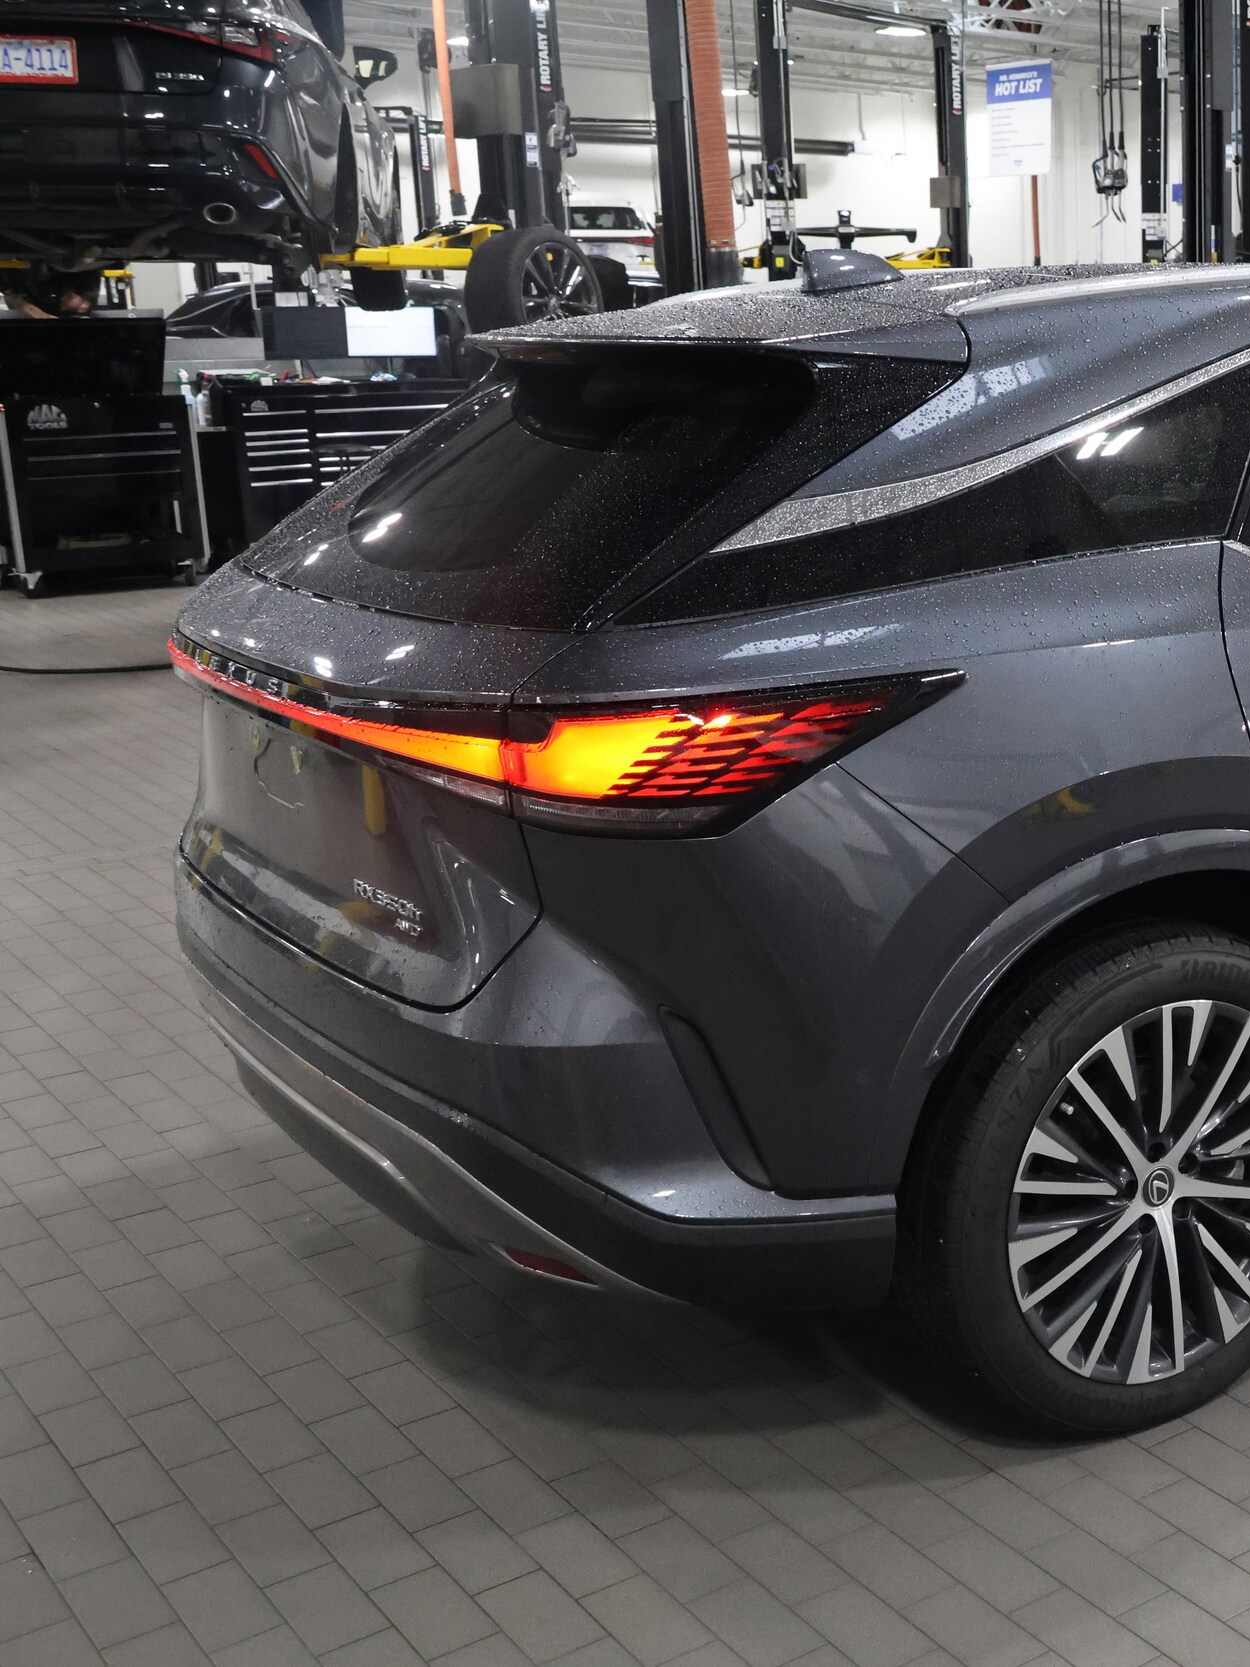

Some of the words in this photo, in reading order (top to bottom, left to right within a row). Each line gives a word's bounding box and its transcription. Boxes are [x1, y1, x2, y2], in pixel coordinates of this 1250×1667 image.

[537, 32, 552, 85] ROTARY
[951, 35, 961, 60] LIFT
[951, 63, 962, 109] ROTARY
[994, 80, 1018, 97] HOT
[1018, 77, 1043, 94] LIST
[418, 116, 426, 137] LIFT
[420, 139, 430, 166] ROTARY
[28, 421, 68, 430] TOOLS
[194, 648, 280, 694] LEXUS
[394, 918, 424, 937] AWD
